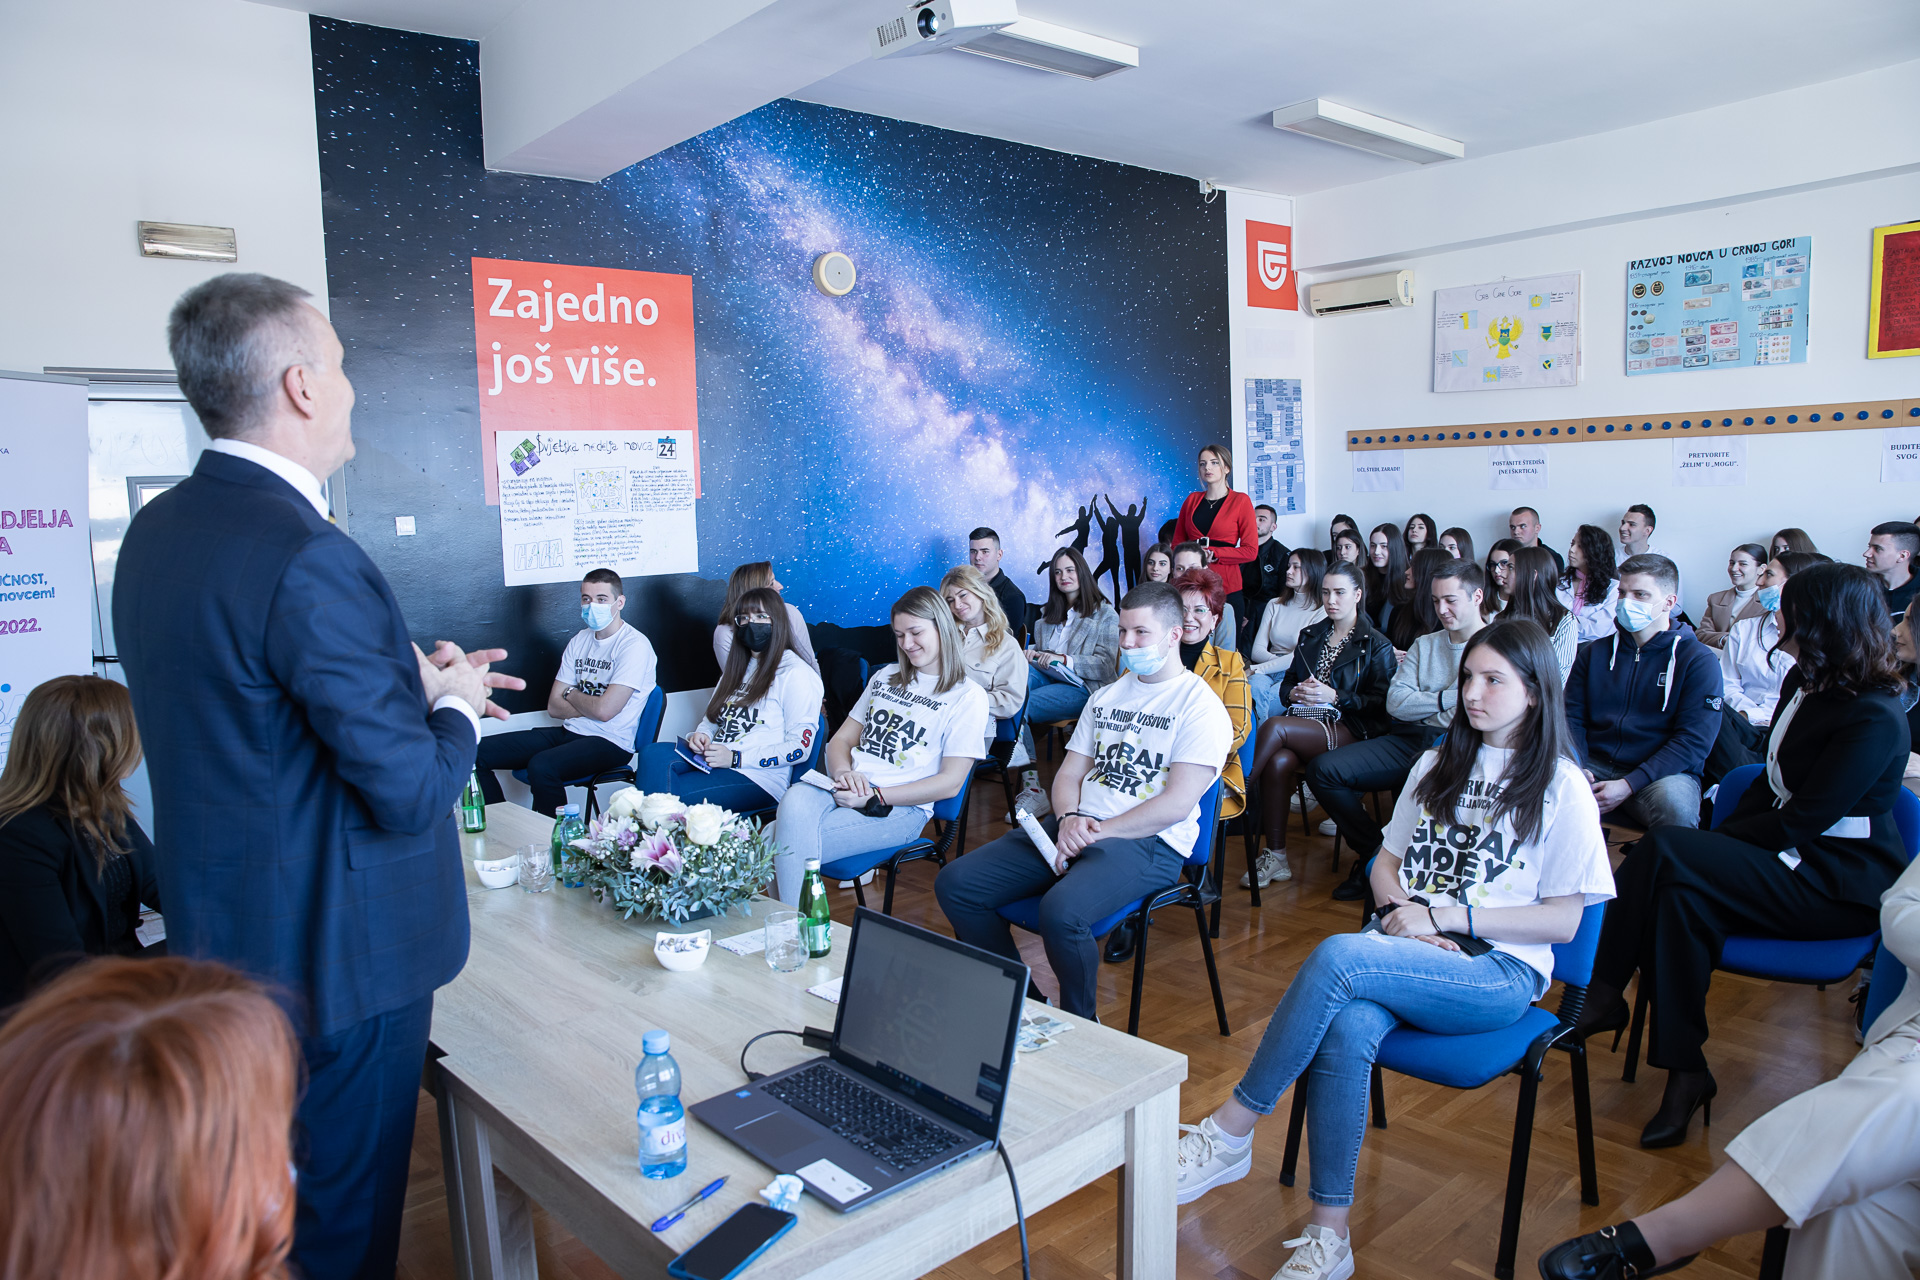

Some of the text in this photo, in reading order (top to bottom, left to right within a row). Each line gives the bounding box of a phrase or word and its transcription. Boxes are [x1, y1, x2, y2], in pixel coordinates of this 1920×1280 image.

[1630, 238, 1796, 271] RAZVOJ NOVCA U CRNOJ GORI
[488, 278, 659, 333] Zajedno
[488, 341, 657, 396] još više.
[624, 441, 654, 451] novca
[659, 443, 675, 457] 24
[0, 509, 74, 530] DJELJA
[0, 587, 56, 602] novcem!
[0, 618, 42, 636] 2022.
